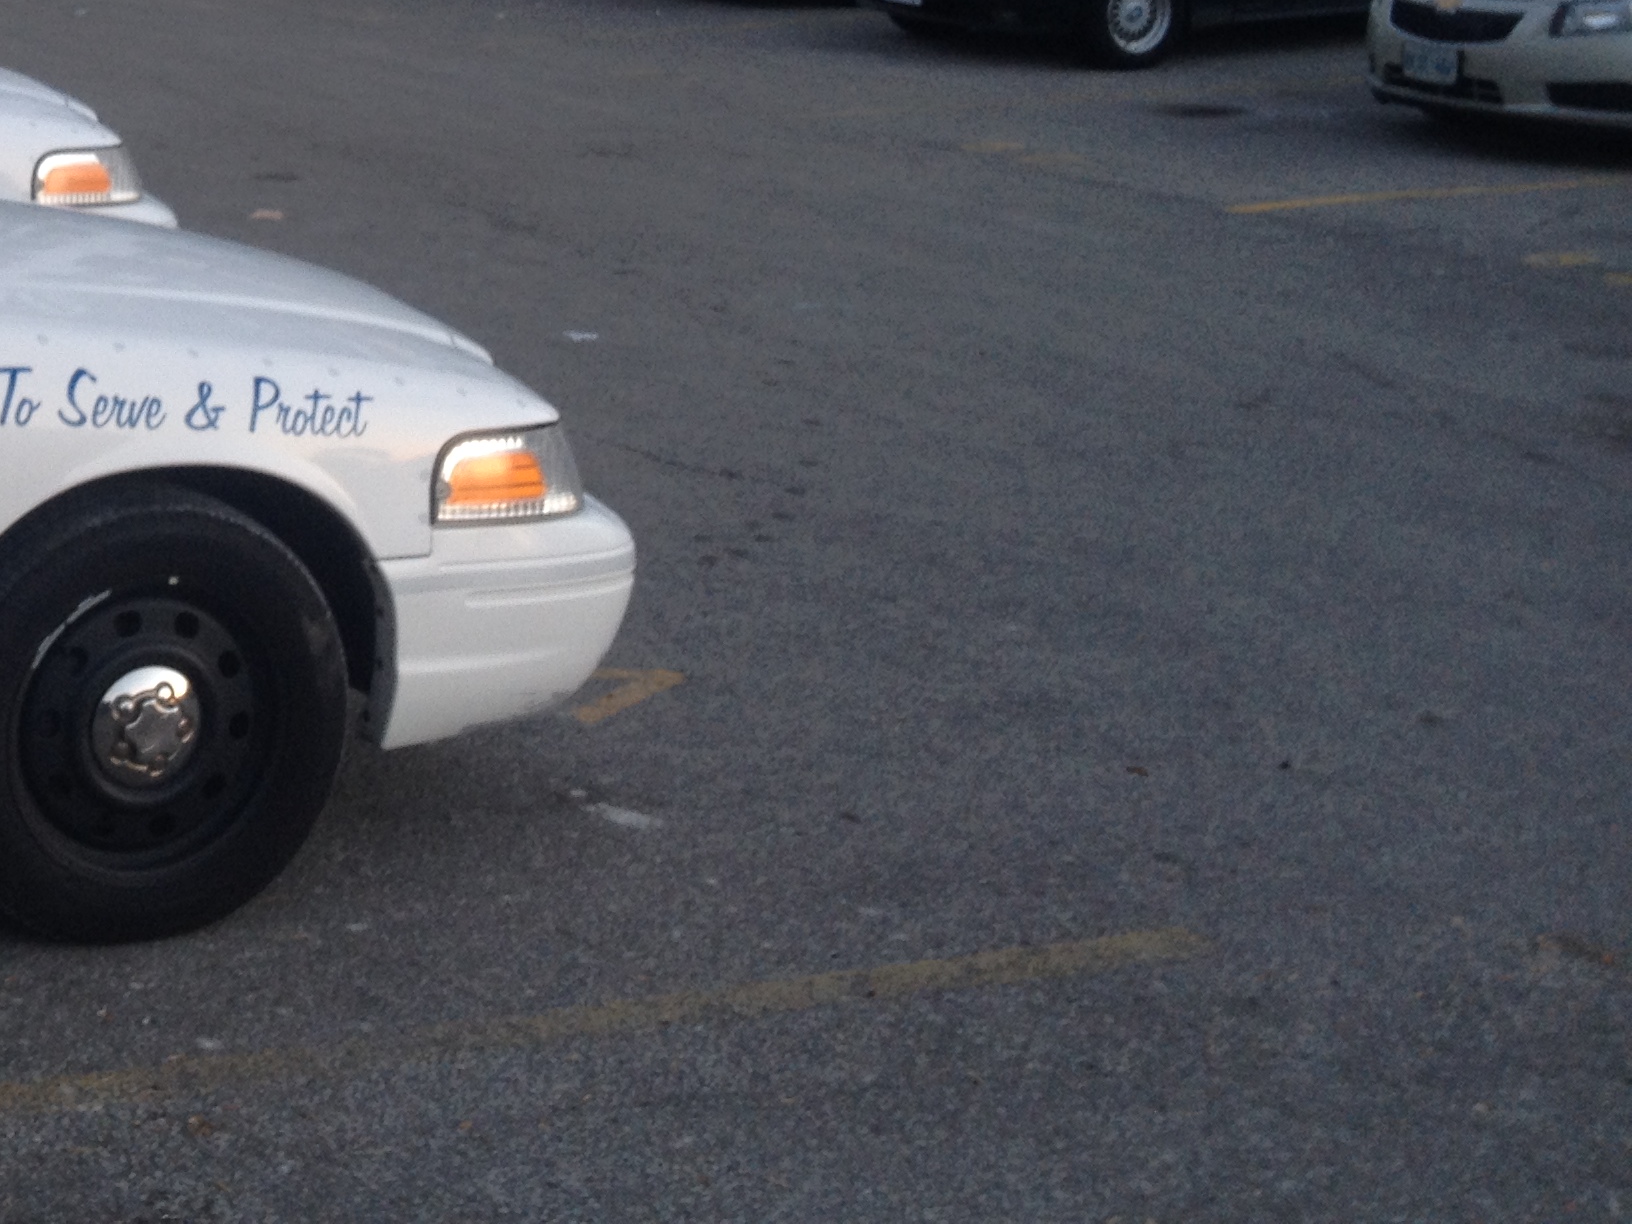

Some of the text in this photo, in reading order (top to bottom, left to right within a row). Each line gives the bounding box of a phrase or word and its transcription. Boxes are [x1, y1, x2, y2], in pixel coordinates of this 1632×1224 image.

[58, 366, 167, 430] Serve
[184, 380, 226, 431] &
[249, 375, 373, 438] Protect
